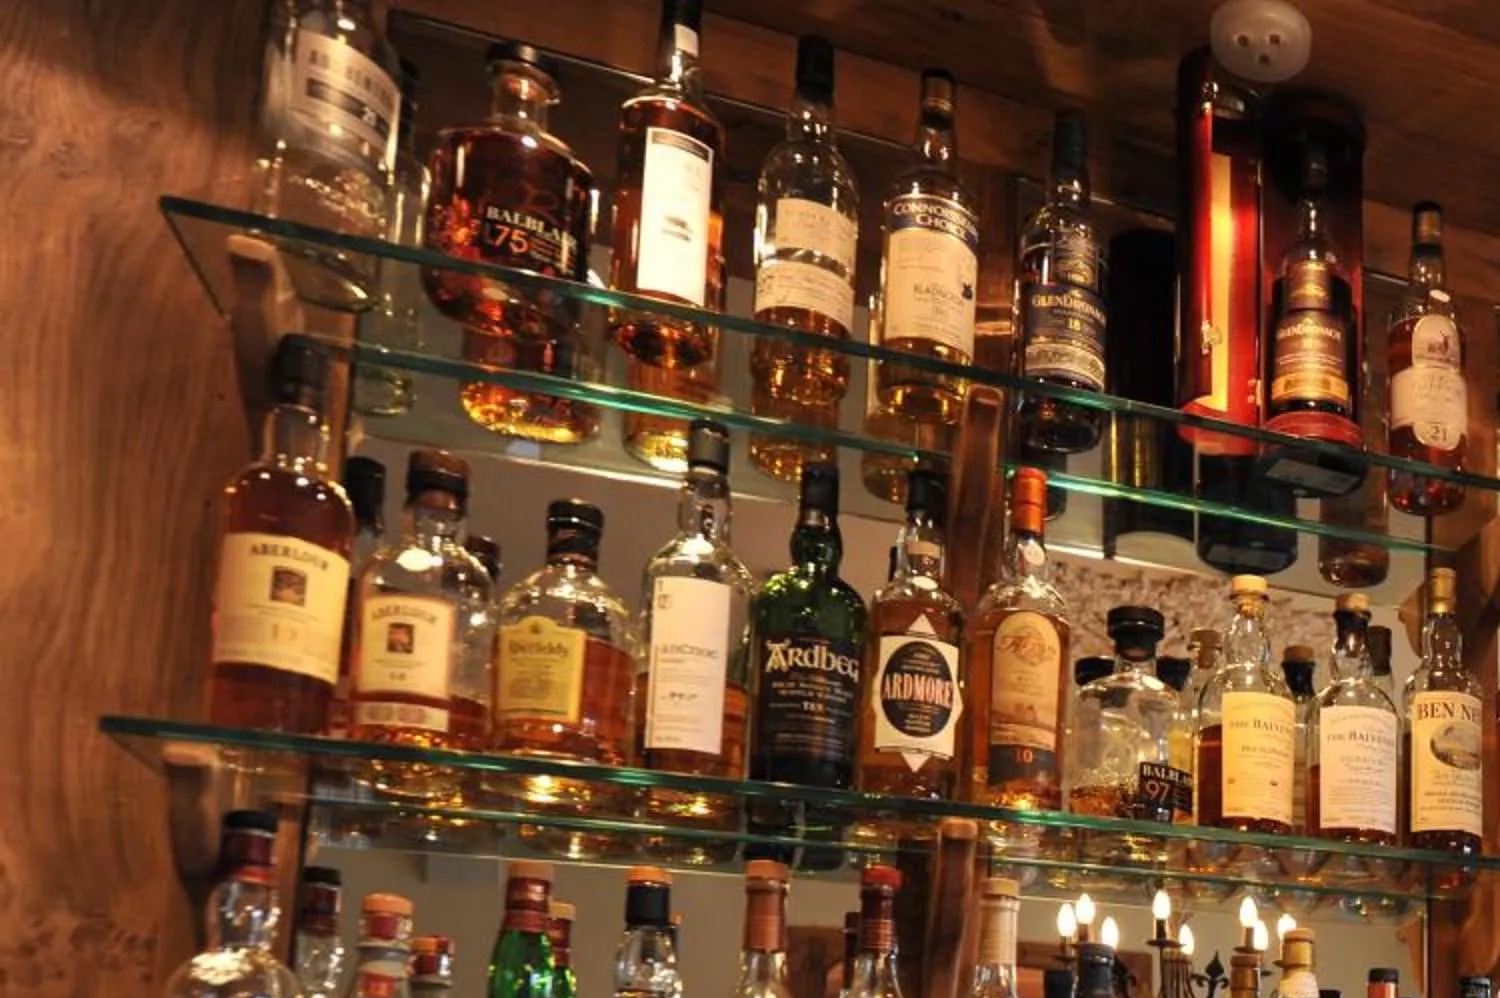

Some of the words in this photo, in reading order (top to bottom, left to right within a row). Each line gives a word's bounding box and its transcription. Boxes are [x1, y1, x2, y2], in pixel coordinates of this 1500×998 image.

[766, 640, 860, 684] Ardbeg
[884, 673, 952, 708] ARDMORE
[1417, 702, 1454, 722] BEN
